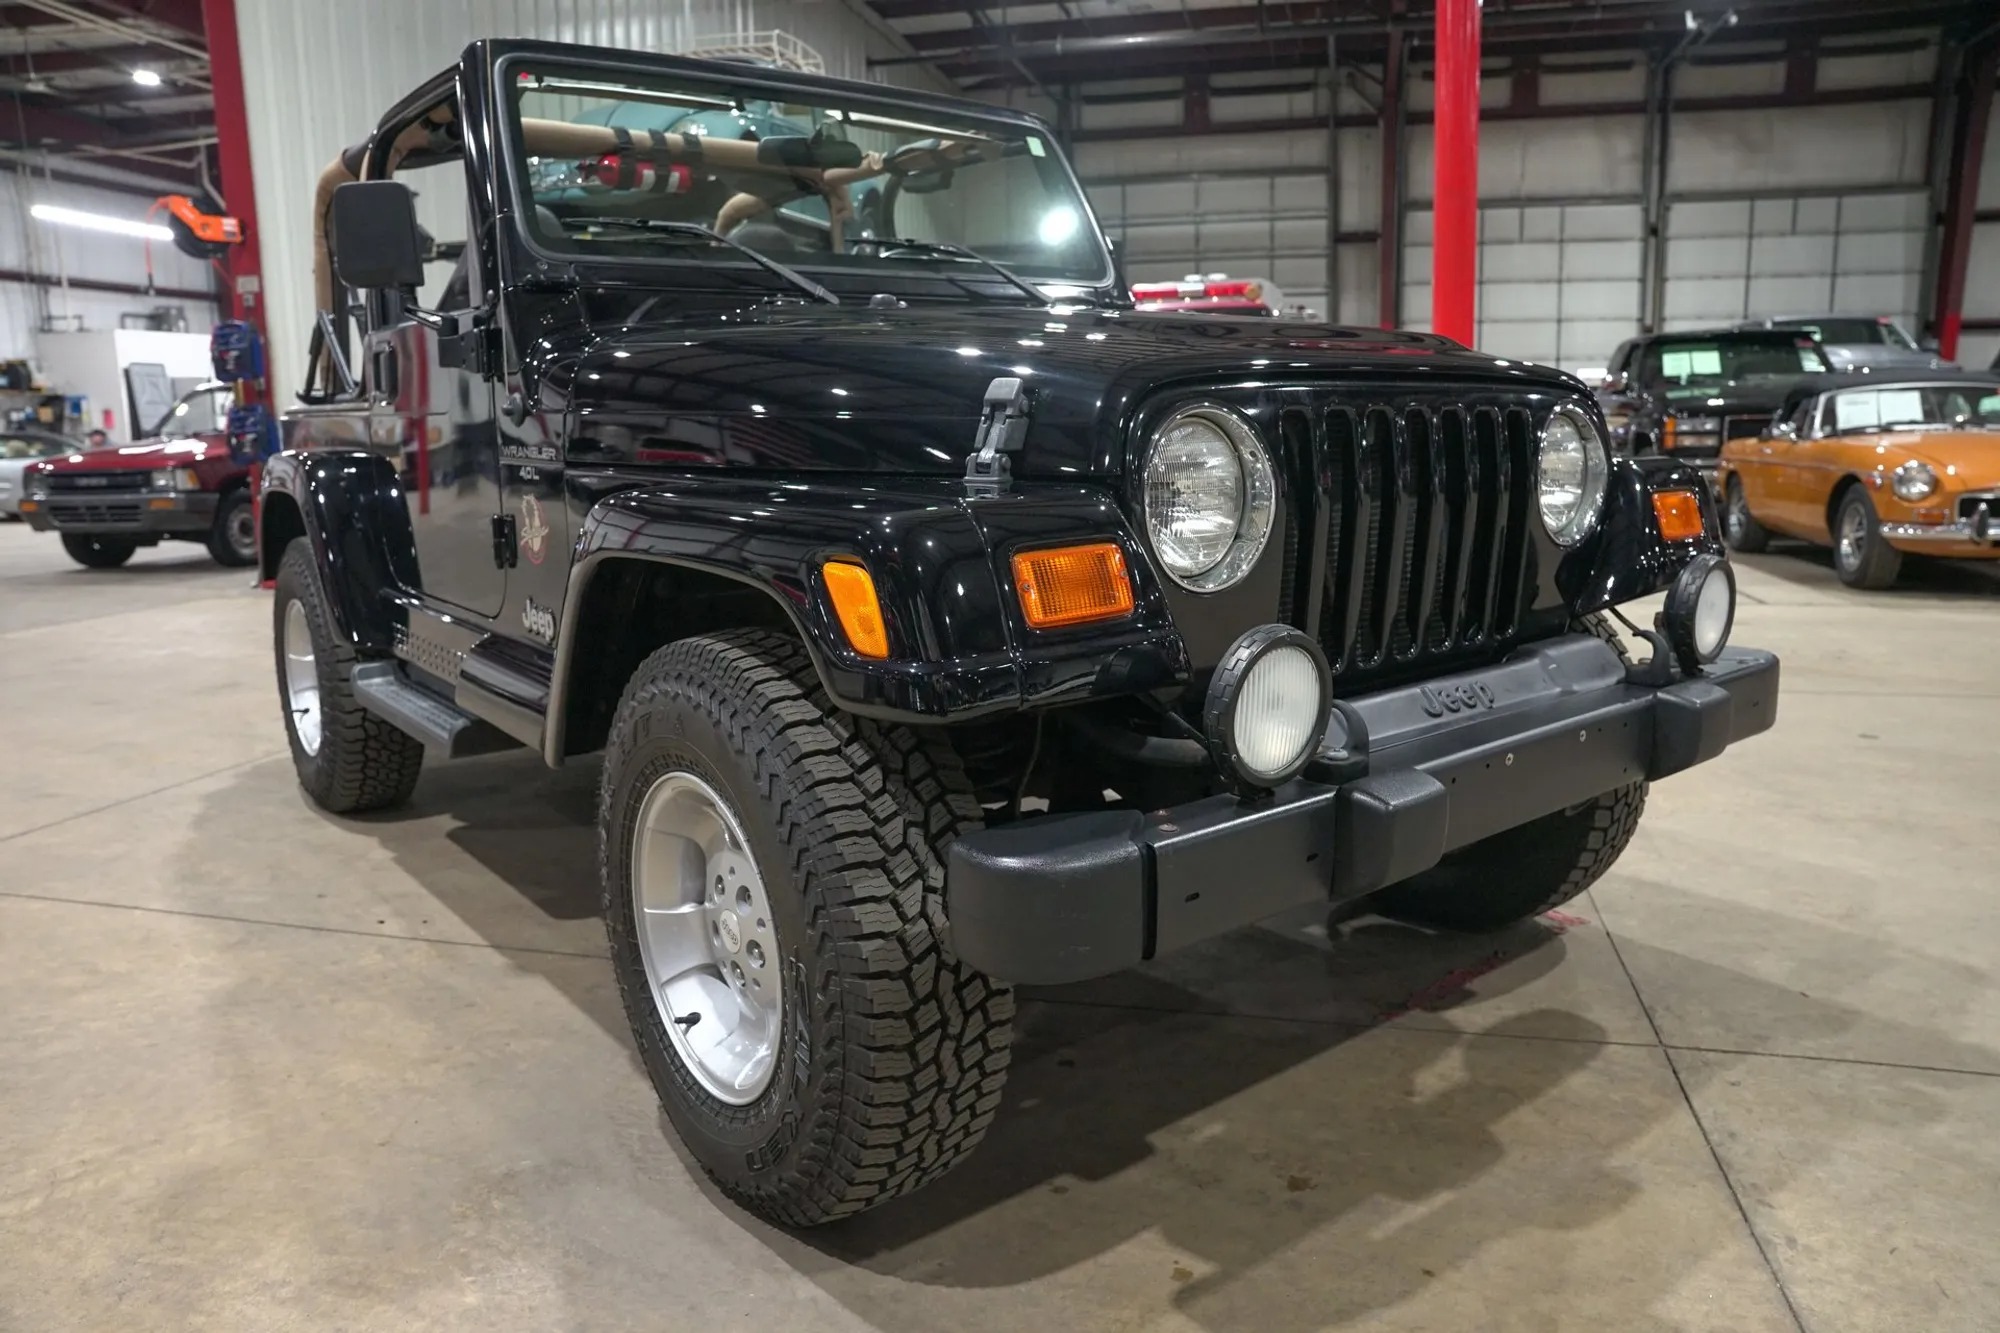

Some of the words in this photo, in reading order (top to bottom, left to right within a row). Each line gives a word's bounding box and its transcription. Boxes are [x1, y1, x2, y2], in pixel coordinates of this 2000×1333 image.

[501, 445, 557, 461] WRANGLER
[522, 599, 556, 641] Jeep
[1419, 681, 1495, 719] Jeep
[721, 919, 739, 946] Jeep
